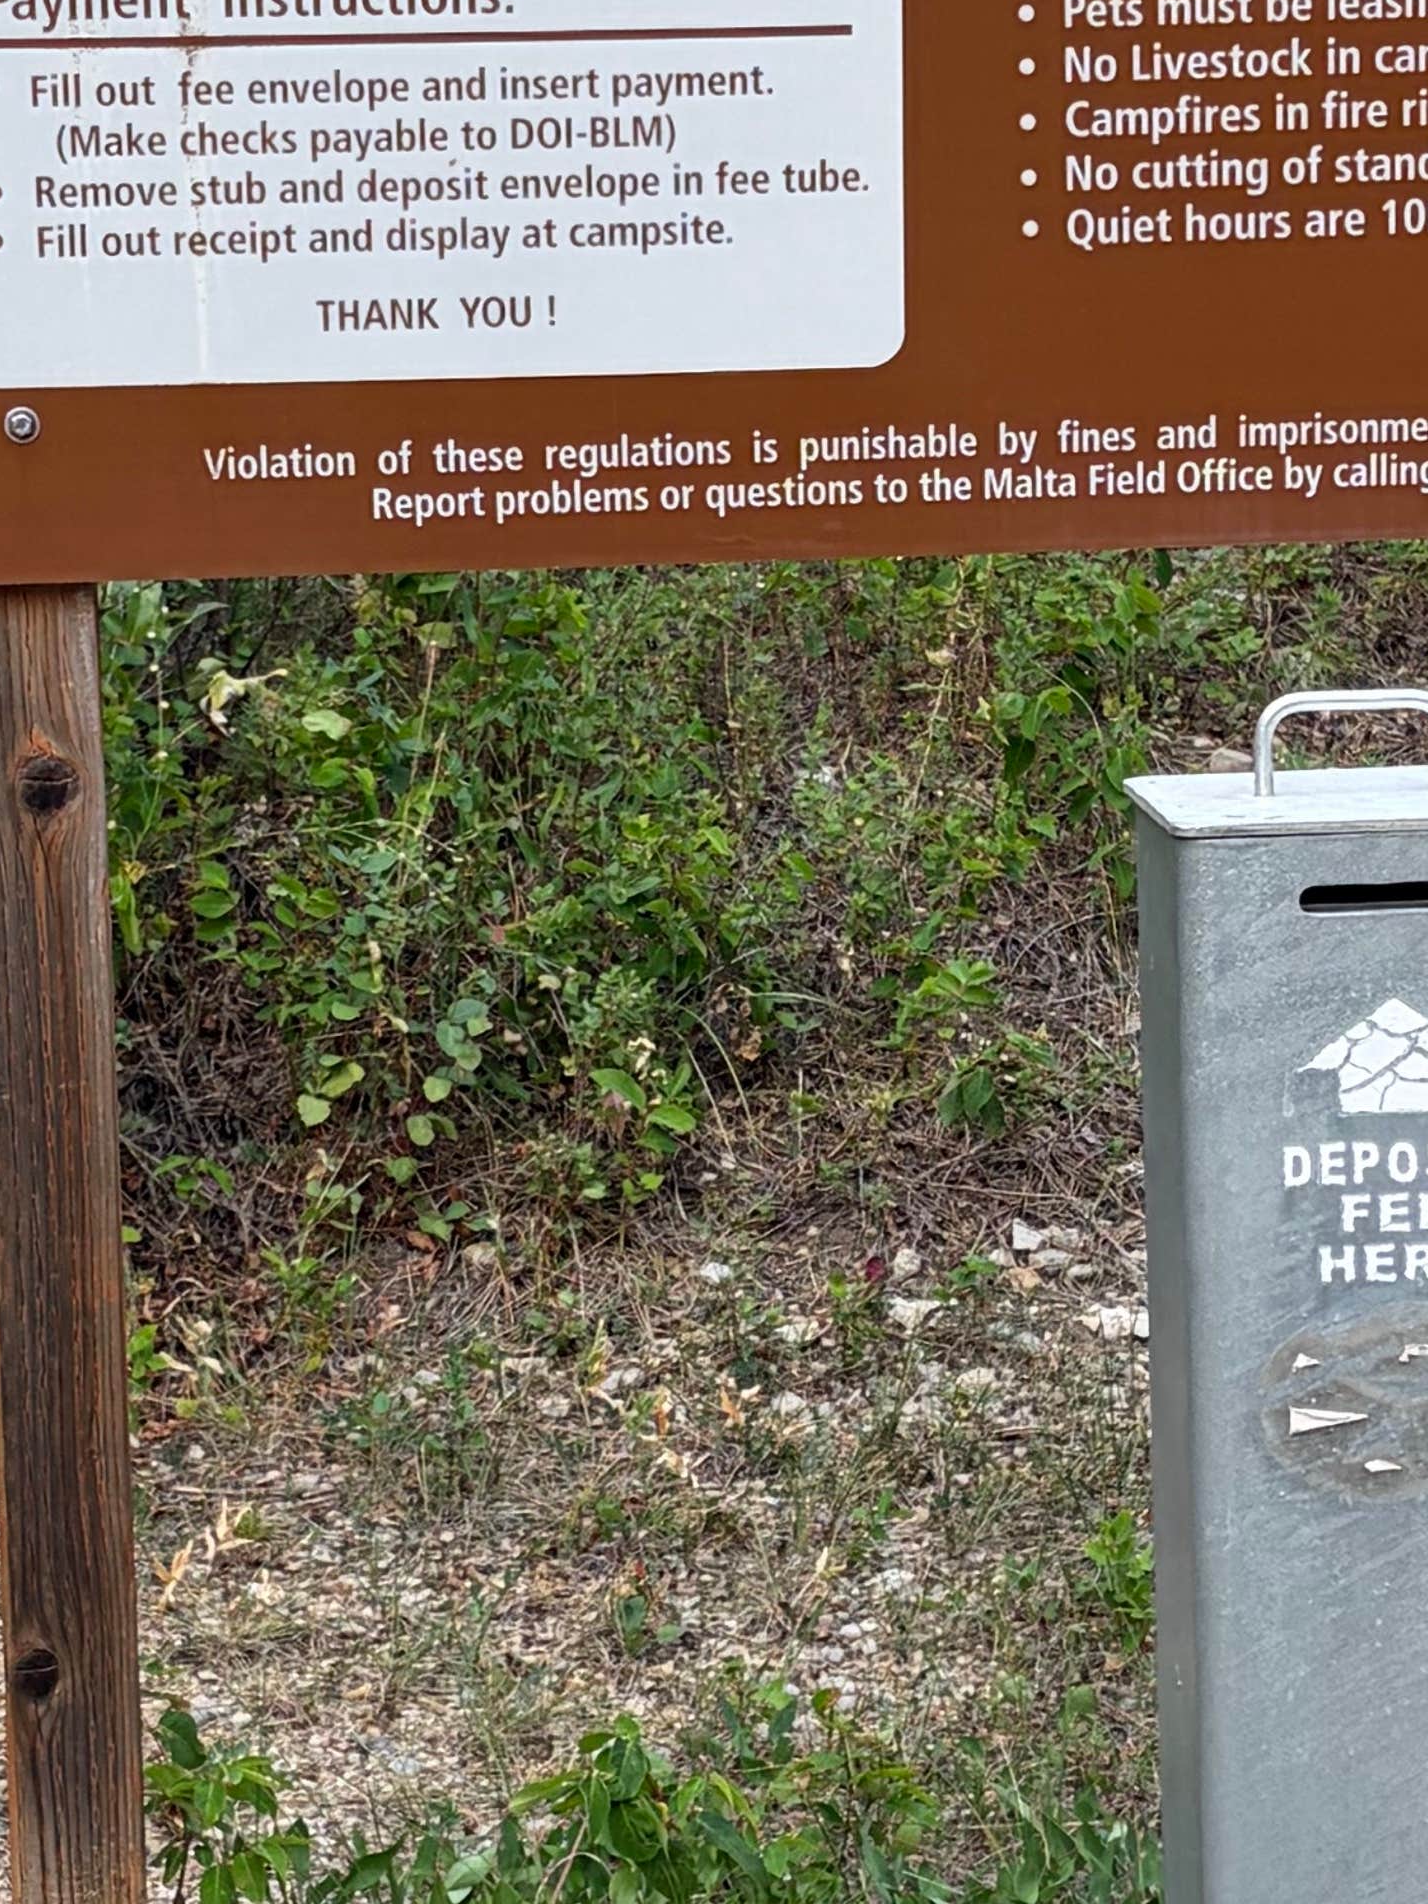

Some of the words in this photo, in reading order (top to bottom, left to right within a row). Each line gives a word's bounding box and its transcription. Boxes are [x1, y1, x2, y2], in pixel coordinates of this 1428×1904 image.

[1064, 45, 1117, 83] No
[1132, 37, 1313, 81] Livestock
[1327, 36, 1361, 75] in
[31, 72, 81, 108] Fill
[95, 76, 156, 107] out
[177, 70, 234, 107] fee
[247, 68, 410, 112] envelope
[422, 66, 486, 102] and
[500, 66, 600, 100] insert
[612, 66, 773, 107] payment.
[56, 122, 167, 165] (Make
[180, 119, 298, 156] checks
[310, 118, 449, 167] payable
[461, 122, 498, 152] to
[510, 113, 678, 155] DOI-BLM)
[1065, 94, 1261, 145] Campfires
[1275, 92, 1309, 131] in
[1321, 89, 1388, 129] fire
[35, 175, 178, 208] Remove
[190, 170, 267, 207] stub
[279, 168, 344, 204] and
[357, 167, 491, 212] deposit
[500, 163, 660, 206] envelope
[673, 162, 703, 196] in
[715, 160, 770, 195] fee
[782, 158, 869, 194] tube.
[37, 223, 87, 258] Fill
[101, 226, 162, 257] out
[174, 221, 297, 264] receipt
[308, 218, 373, 253] and
[386, 216, 511, 260] display
[522, 219, 558, 249] at
[569, 211, 733, 255] campsite.
[1066, 205, 1173, 251] Quiet
[1185, 203, 1292, 242] hours
[1304, 208, 1366, 238] are
[315, 297, 440, 332] THANK
[459, 295, 532, 329] YOU
[203, 443, 356, 480] Violation
[377, 439, 413, 475] of
[432, 438, 524, 474] these
[545, 432, 732, 478] regulations
[753, 430, 778, 463] is
[800, 423, 978, 472] punishable
[999, 421, 1038, 464] by
[1057, 419, 1136, 454] fines
[1157, 414, 1217, 450] and
[372, 486, 486, 528] Report
[495, 478, 649, 525] problems
[660, 484, 695, 510] or
[705, 472, 864, 518] questions
[873, 473, 908, 504] to
[918, 467, 972, 502] the
[984, 465, 1077, 500] Malta
[1089, 459, 1166, 496] Field
[1176, 457, 1273, 493] Office
[1284, 455, 1323, 498] by
